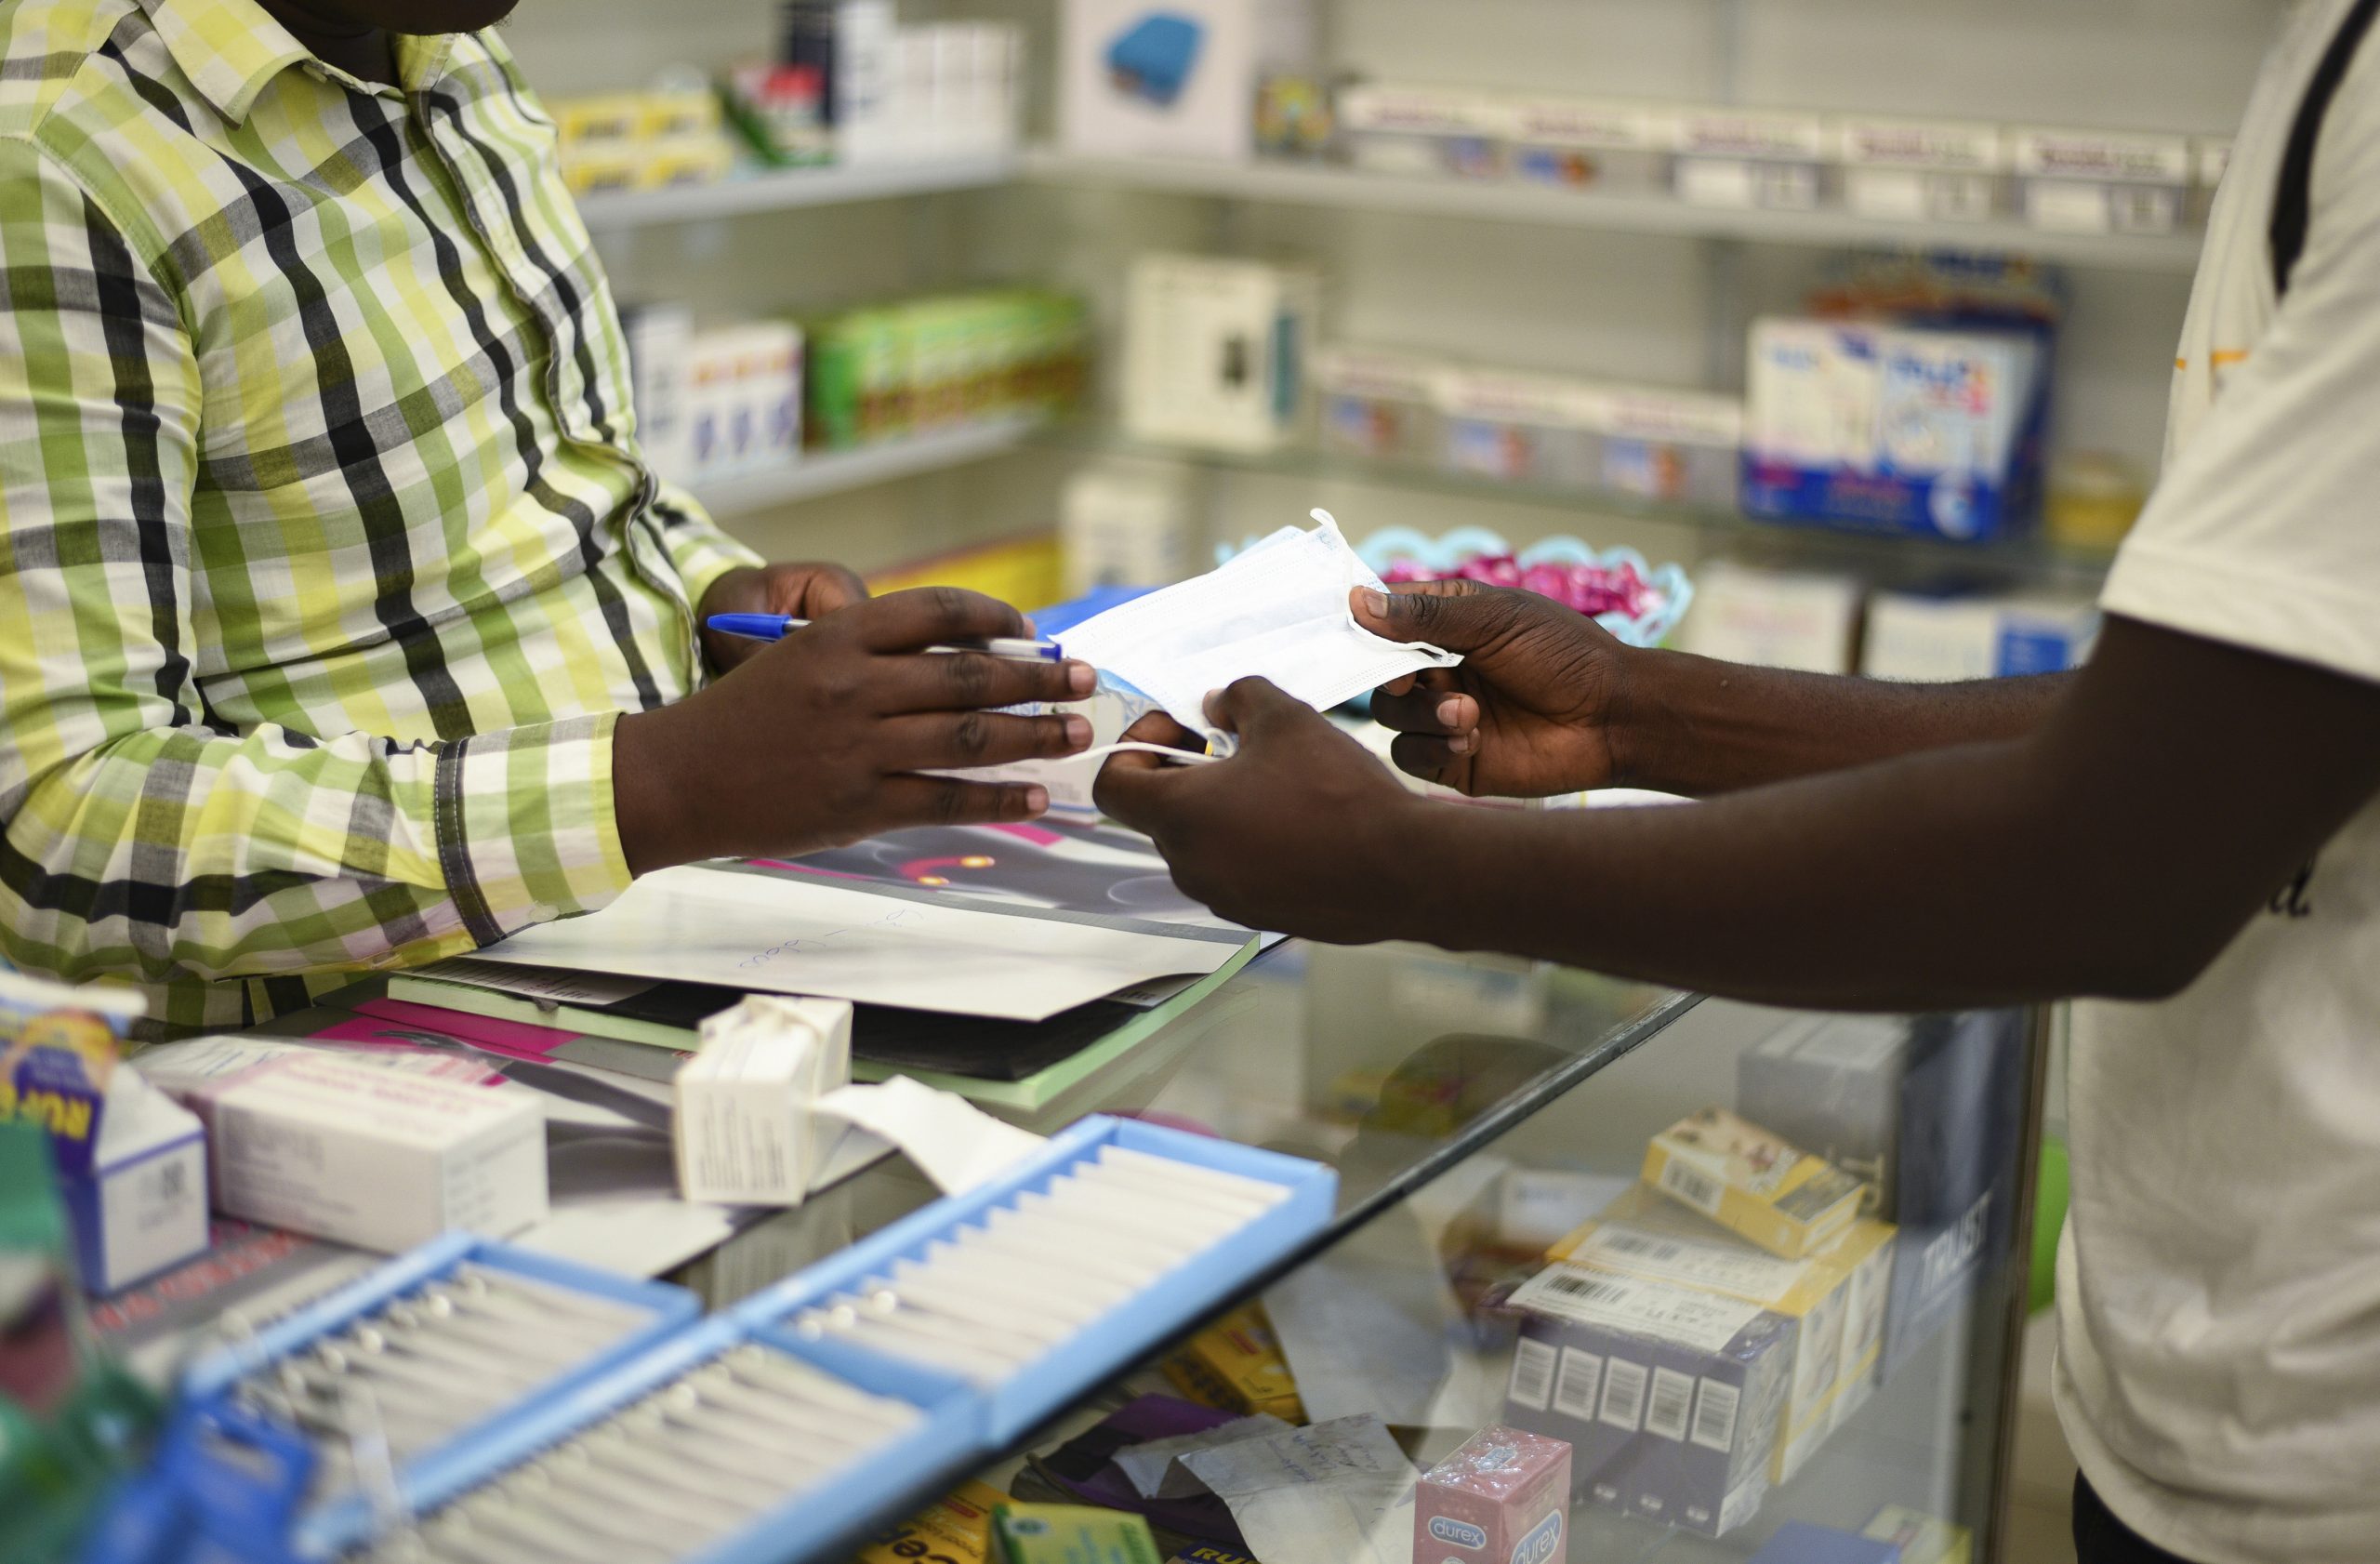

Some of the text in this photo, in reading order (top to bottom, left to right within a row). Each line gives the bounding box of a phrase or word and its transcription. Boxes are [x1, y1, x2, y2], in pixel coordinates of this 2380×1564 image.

[1434, 1520, 1481, 1546] durex
[1516, 1521, 1557, 1564] durex
[1191, 1546, 1261, 1564] RU
